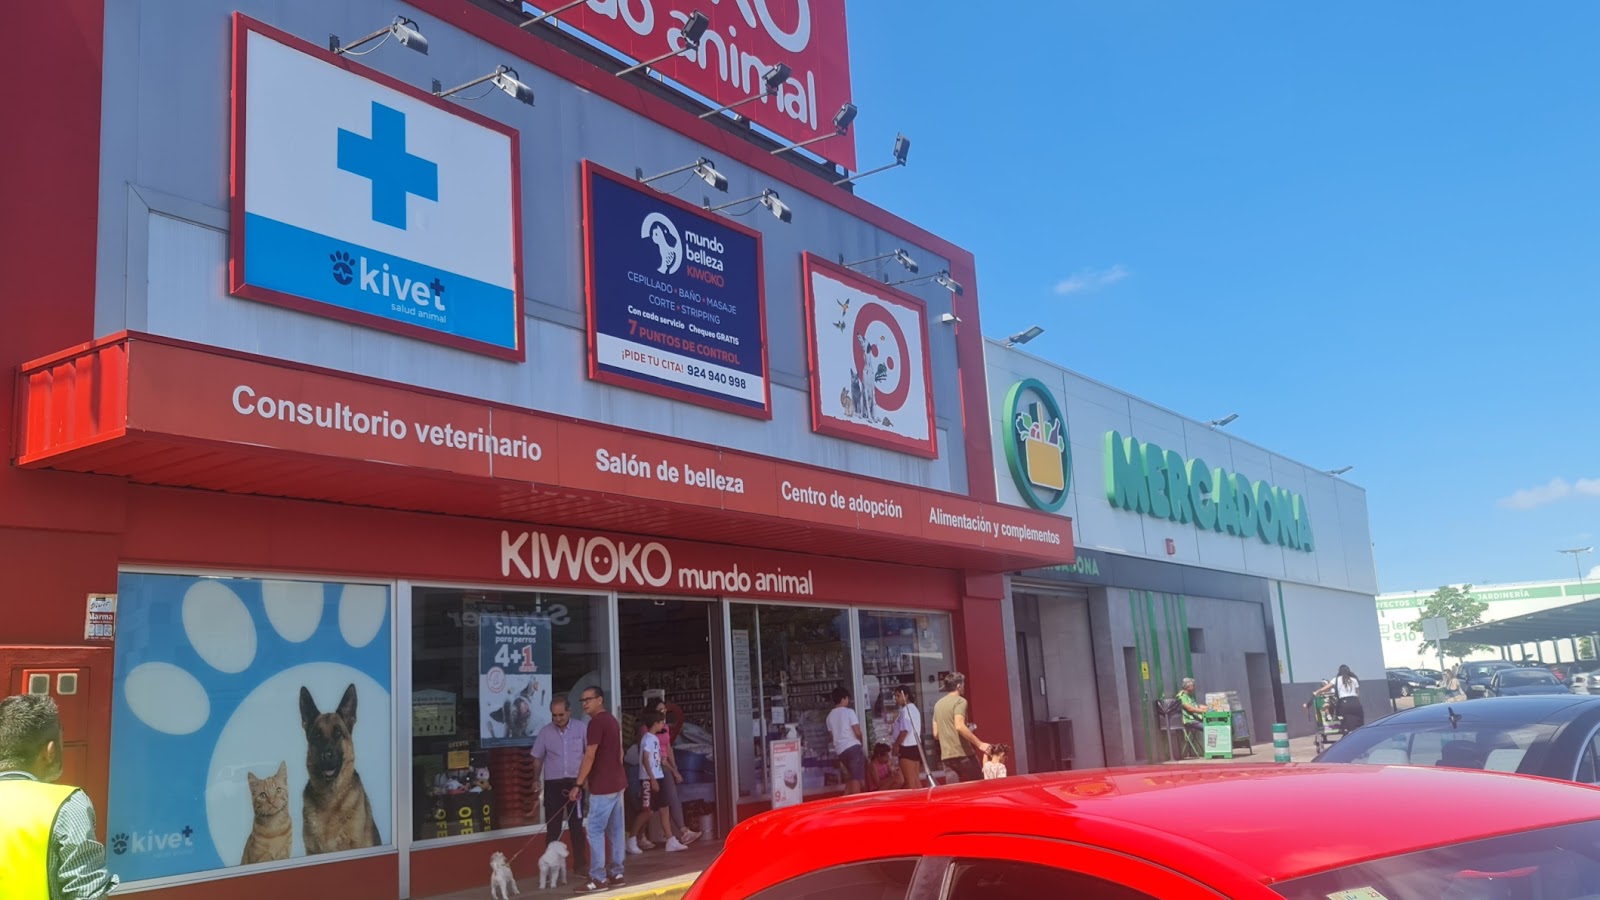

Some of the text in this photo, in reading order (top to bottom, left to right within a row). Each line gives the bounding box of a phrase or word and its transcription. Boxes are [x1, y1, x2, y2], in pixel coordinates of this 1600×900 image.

[667, 10, 817, 131] animal
[685, 230, 724, 254] mundo
[686, 244, 724, 272] belleza
[360, 256, 446, 311] kivet
[627, 271, 737, 315] CEPILLADO BAÑO MASAJE
[687, 265, 724, 288] KIWOKO
[391, 303, 447, 324] salud animal
[628, 305, 740, 346] Con cada servicio Chequeo GRATIS
[649, 294, 720, 325] CORTE STRIPPING
[628, 319, 740, 365] 7 PUNTOS DE CONTROL
[621, 349, 746, 389] ¡PIDE TU CITA! 924 940 998
[232, 385, 542, 461] Consultorio veterinario
[595, 448, 744, 494] Salón de belleza
[781, 481, 903, 519] Centro de adopción
[1105, 430, 1315, 552] MERCADONA
[929, 507, 1060, 545] Alimentación y complementos
[500, 530, 814, 596] KIWOKO mundo animal
[1376, 600, 1410, 609] YECTOS
[1478, 589, 1530, 602] JARDINERÍA
[495, 622, 537, 636] Snacks
[495, 636, 537, 645] para perros
[1394, 632, 1416, 642] 910
[131, 826, 193, 854] kivet
